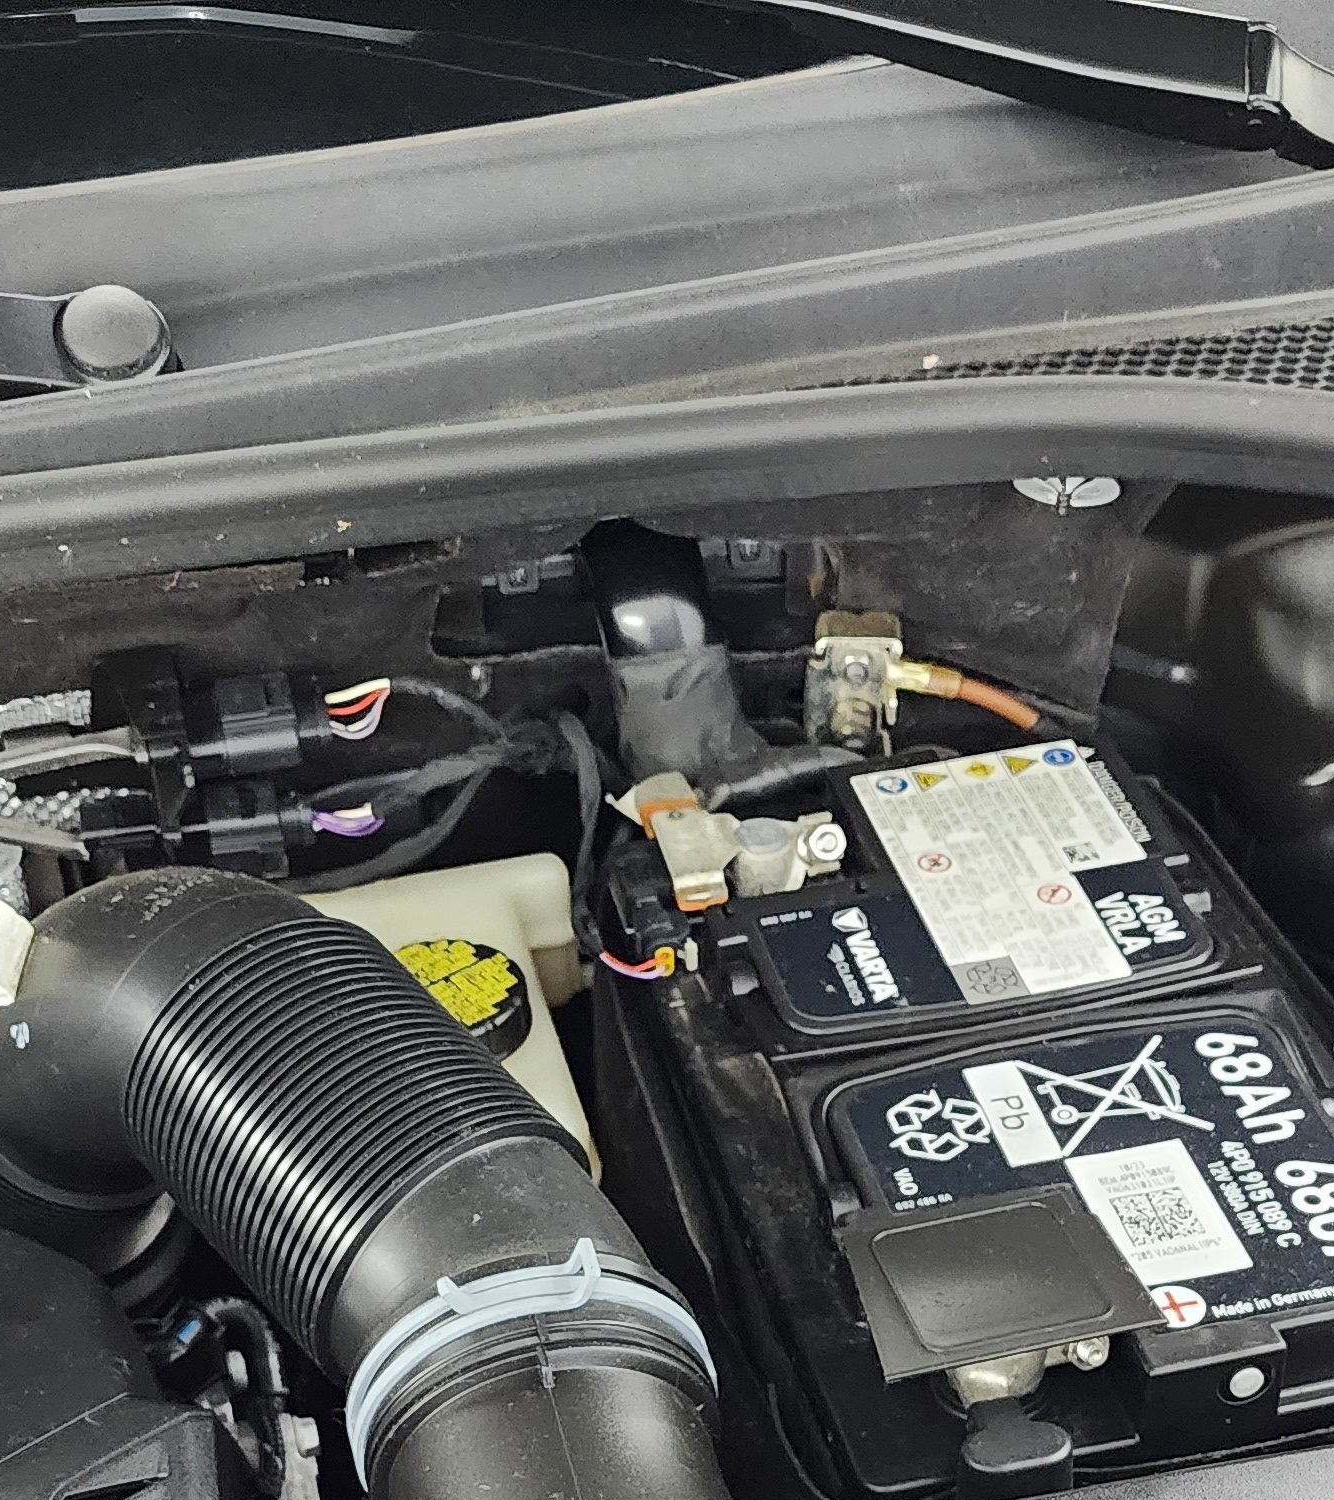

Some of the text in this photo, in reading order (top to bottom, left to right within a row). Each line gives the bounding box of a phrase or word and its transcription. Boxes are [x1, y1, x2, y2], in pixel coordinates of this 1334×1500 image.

[1095, 891, 1152, 956] VRLA
[1128, 894, 1186, 943] AGM
[846, 929, 900, 1004] VARTA
[991, 1095, 1030, 1130] Pb
[1195, 1032, 1306, 1144] 68Ah
[1207, 1160, 1233, 1183] 12V
[1237, 1210, 1264, 1236] DIN
[1221, 1140, 1302, 1249] 4P0 915 089 C
[1211, 1301, 1254, 1318] Made
[1253, 1297, 1272, 1311] in
